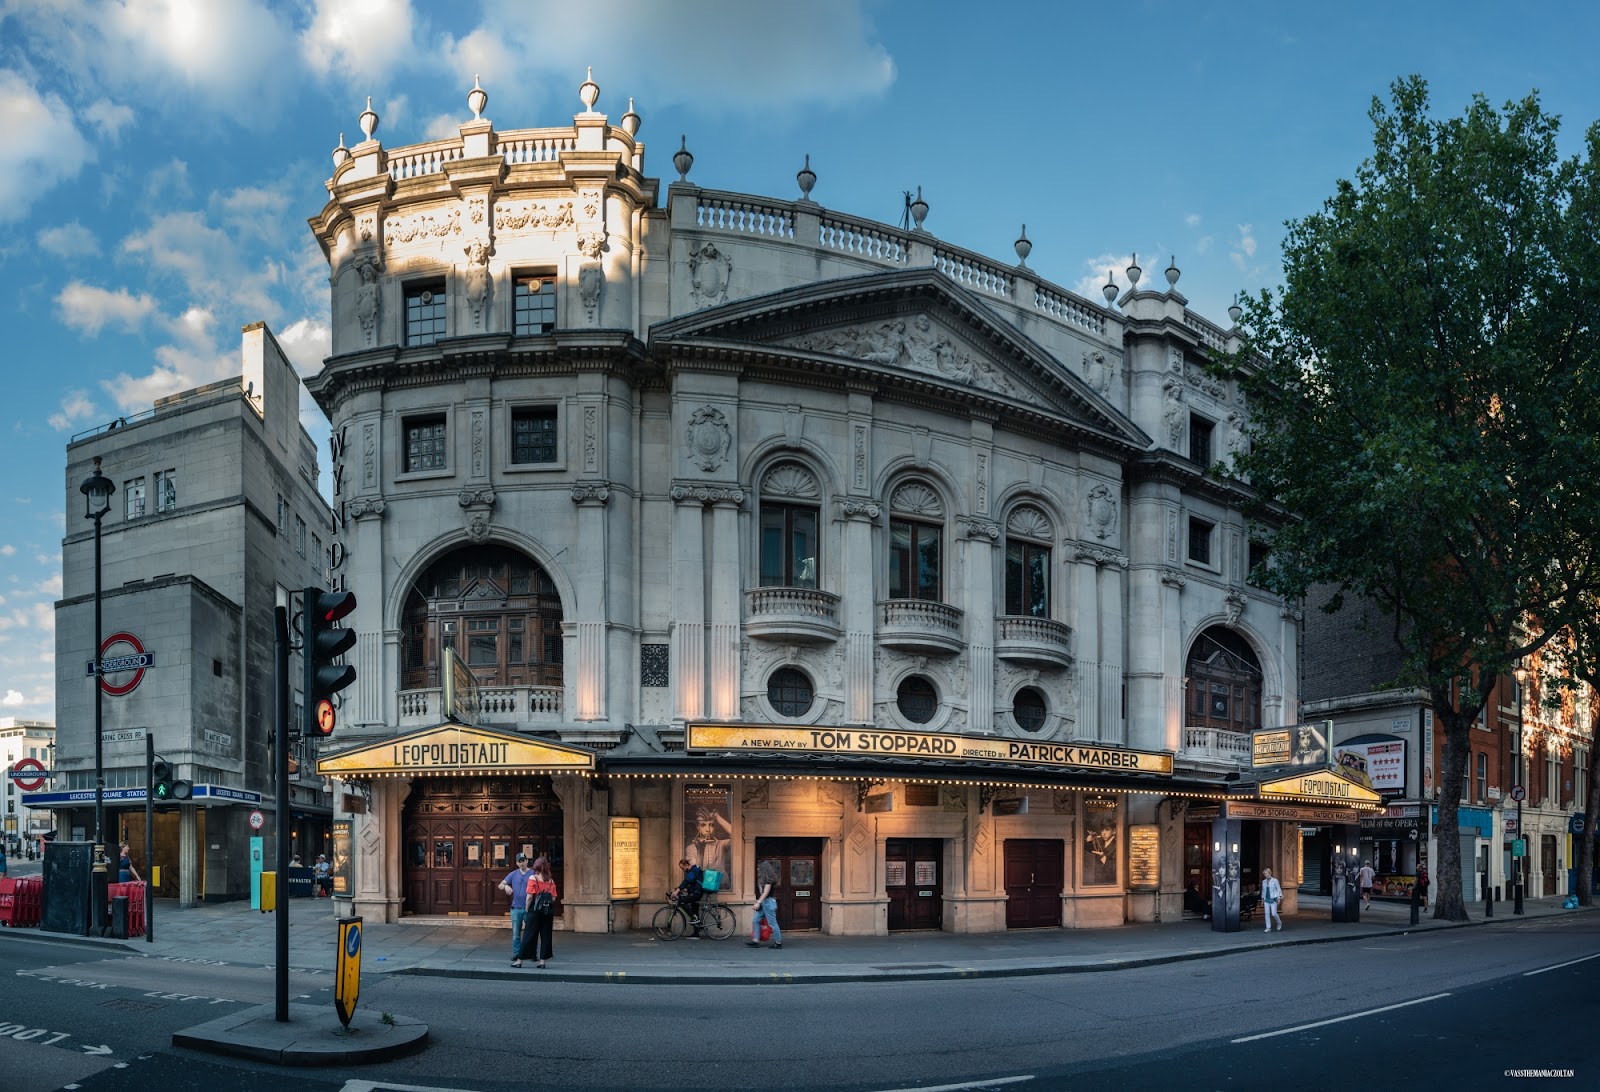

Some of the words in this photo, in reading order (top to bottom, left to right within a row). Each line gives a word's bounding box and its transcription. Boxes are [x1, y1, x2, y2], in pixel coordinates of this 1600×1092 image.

[394, 742, 509, 766] LEOPOLDSTADT
[810, 732, 851, 748] TOM
[857, 734, 957, 754] STOPPARD
[962, 748, 997, 758] DIRECTED
[1009, 743, 1074, 763] PATRICK
[1079, 750, 1139, 768] MARBER
[1300, 779, 1350, 796] LEOPOLDSTADT
[1254, 808, 1266, 816] TOM
[1268, 808, 1298, 818] STOPPARD
[1314, 811, 1334, 820] PATRICK
[1394, 820, 1418, 828] OPERA
[144, 991, 236, 1004] LEFT
